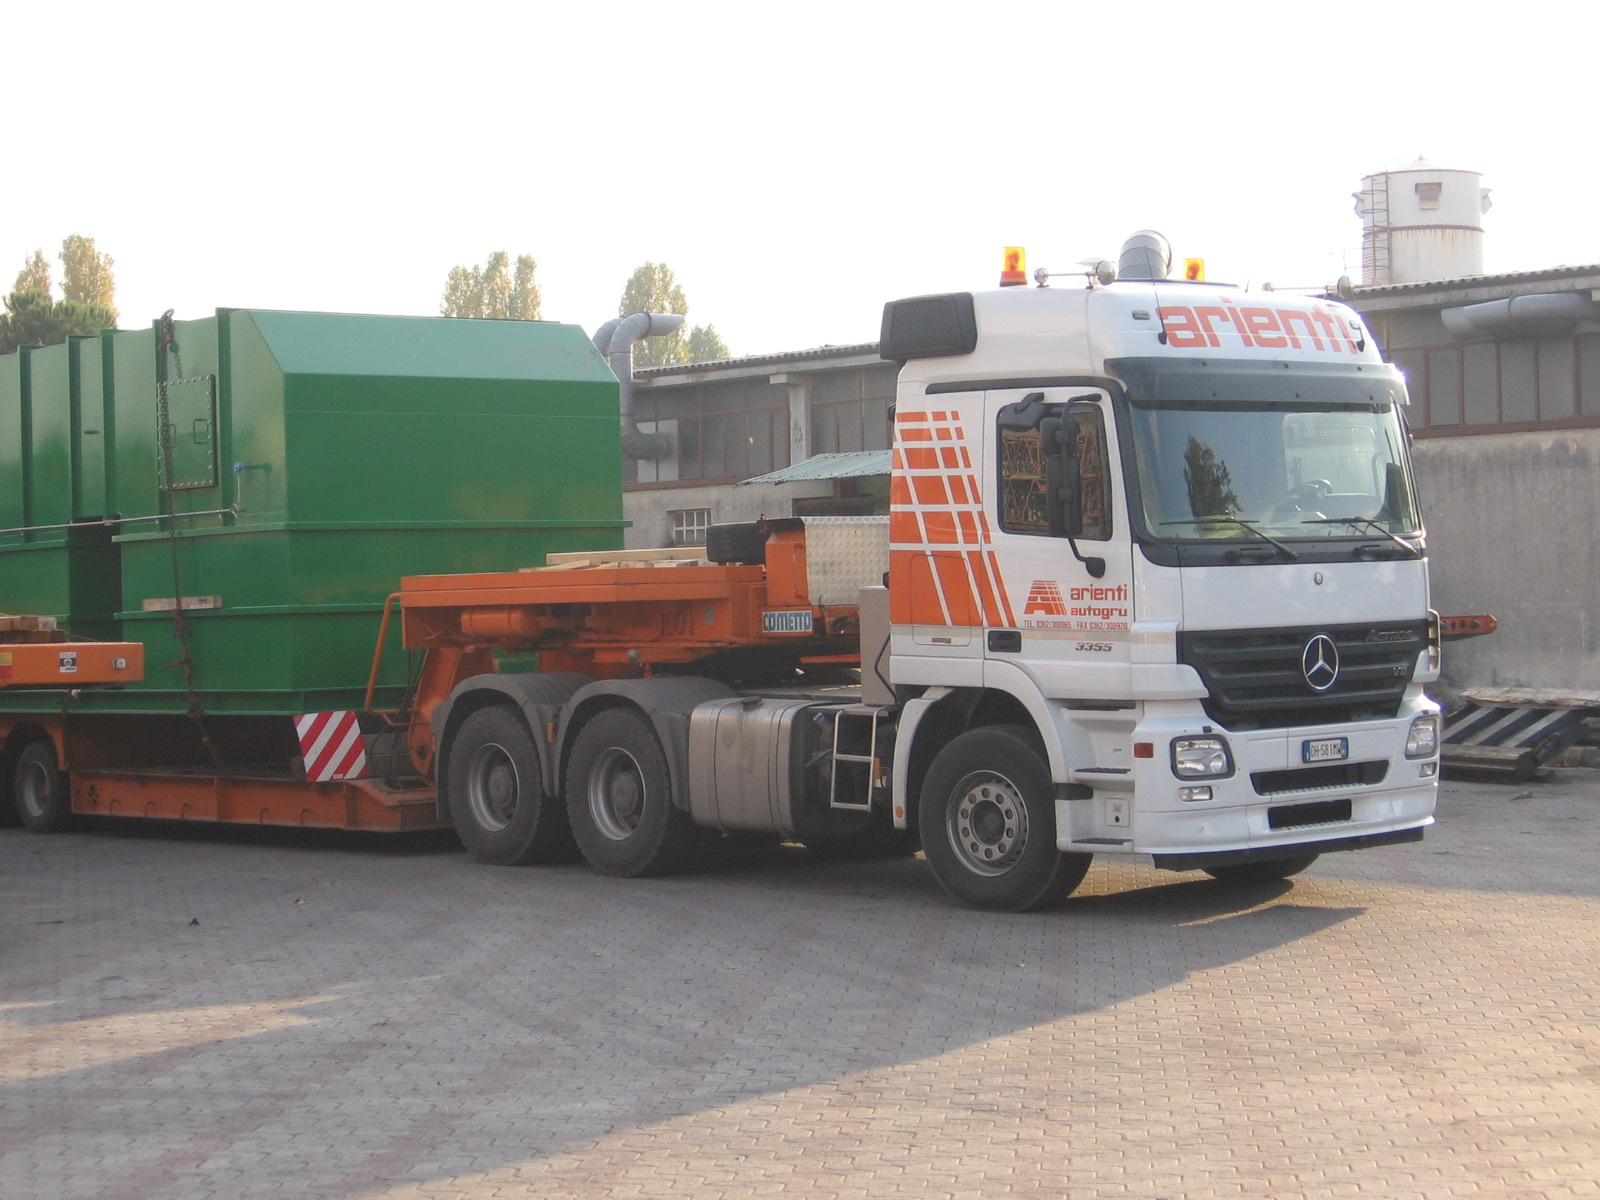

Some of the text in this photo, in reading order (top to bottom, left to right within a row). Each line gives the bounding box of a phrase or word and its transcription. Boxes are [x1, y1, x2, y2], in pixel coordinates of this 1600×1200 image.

[1155, 296, 1358, 354] arienti
[1070, 584, 1128, 601] arienti
[1070, 606, 1128, 619] autogru
[1077, 622, 1088, 630] FAX
[1075, 642, 1114, 652] 3355
